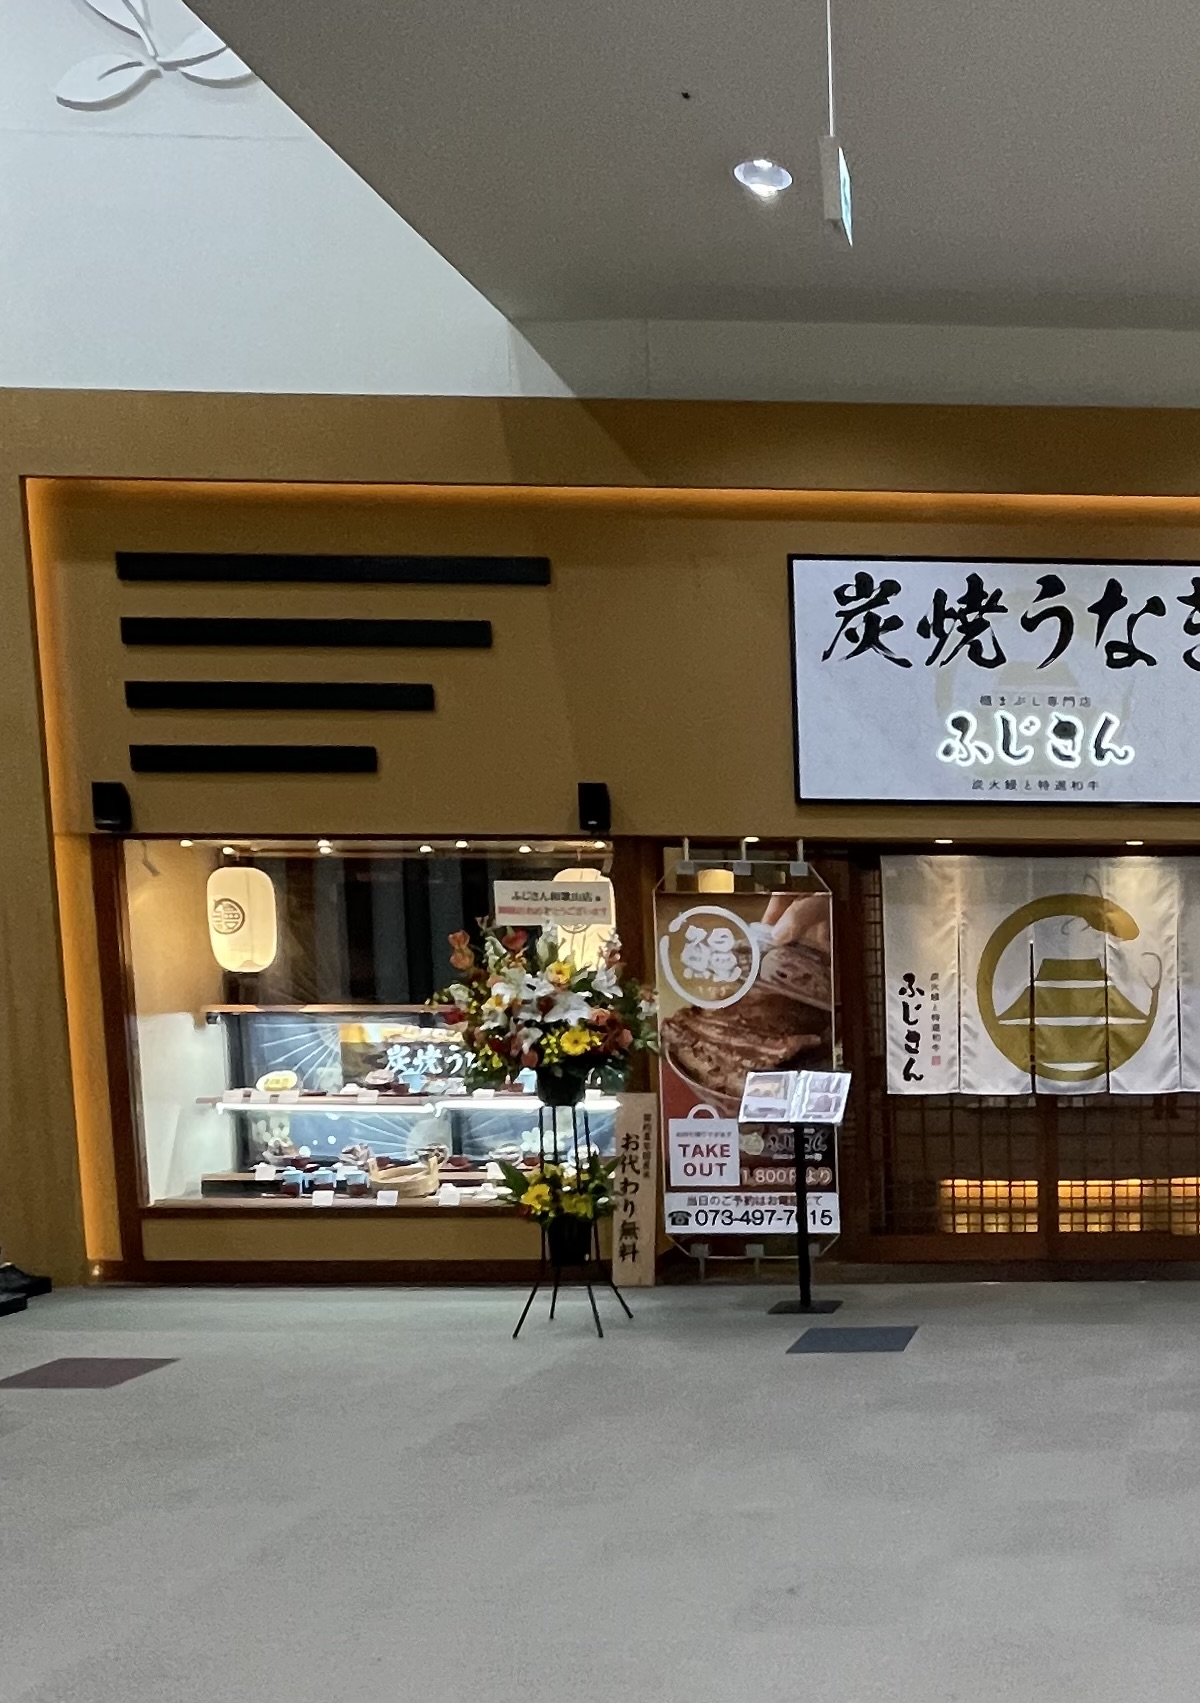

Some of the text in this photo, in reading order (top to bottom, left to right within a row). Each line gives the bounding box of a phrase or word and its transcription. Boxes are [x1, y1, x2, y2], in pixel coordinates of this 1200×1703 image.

[677, 1143, 731, 1158] TAKE
[683, 1162, 728, 1177] OUT
[618, 1132, 641, 1263] お代わり無料
[694, 1209, 833, 1226] 073-497-715
